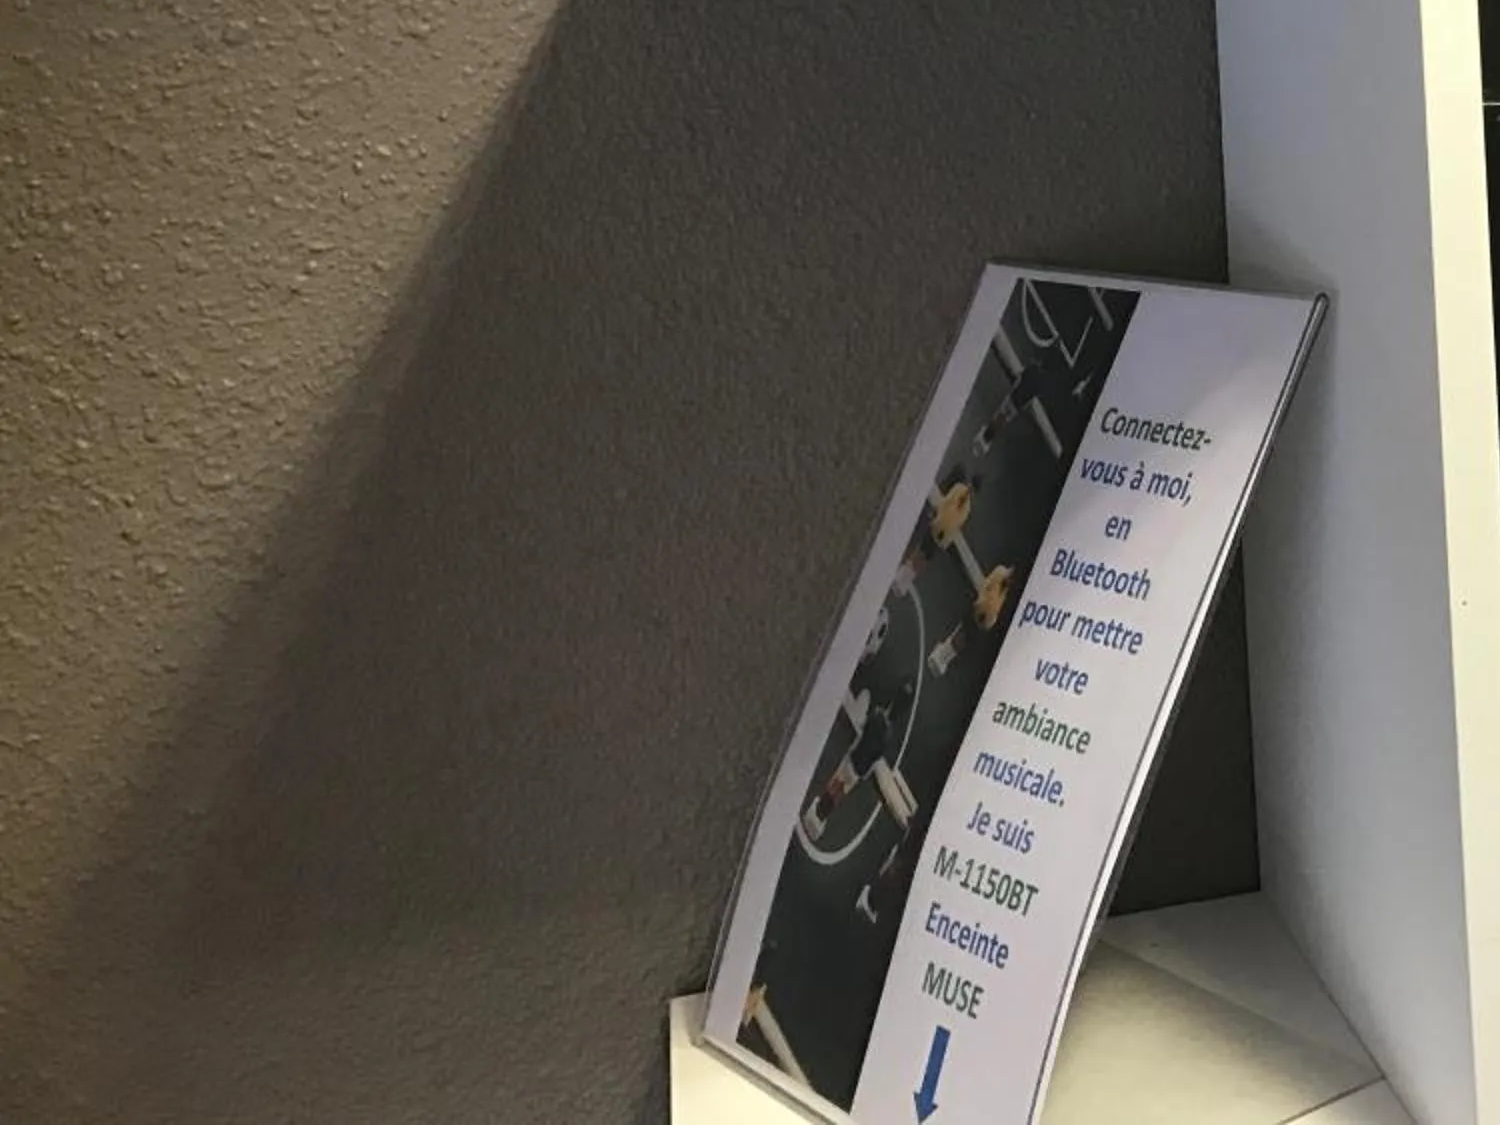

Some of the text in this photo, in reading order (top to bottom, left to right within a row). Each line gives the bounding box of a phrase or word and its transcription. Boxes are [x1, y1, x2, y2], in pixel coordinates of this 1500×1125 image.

[1101, 408, 1212, 451] Connectez-
[1081, 459, 1193, 507] vous à moi,
[1105, 516, 1132, 541] en
[1050, 549, 1152, 601] Bluetooth
[1019, 600, 1143, 655] pour mettre
[1034, 658, 1089, 695] votre
[992, 701, 1092, 754] ambiance
[973, 752, 1065, 807] musicale.
[967, 802, 1035, 854] Je suis
[933, 846, 1040, 917] M-1150BT
[925, 902, 1010, 969] Enceinte
[922, 962, 985, 1020] MUSE
